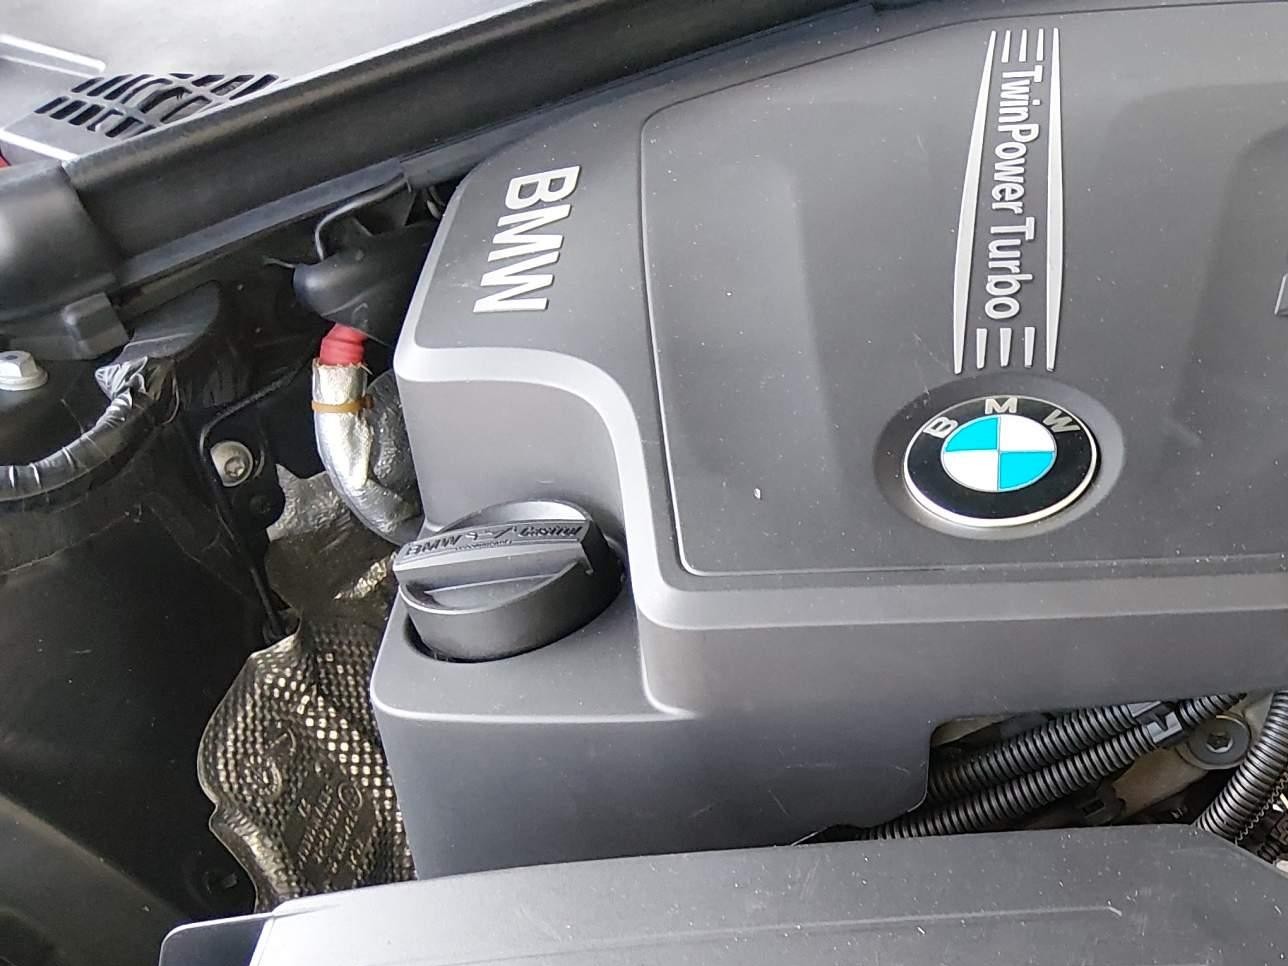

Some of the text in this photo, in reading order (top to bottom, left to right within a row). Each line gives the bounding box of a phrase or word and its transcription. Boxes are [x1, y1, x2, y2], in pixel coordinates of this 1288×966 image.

[984, 64, 1043, 320] TwinPower Turbo
[473, 166, 581, 313] BMW
[923, 397, 1080, 438] BMW
[406, 534, 463, 556] BMW
